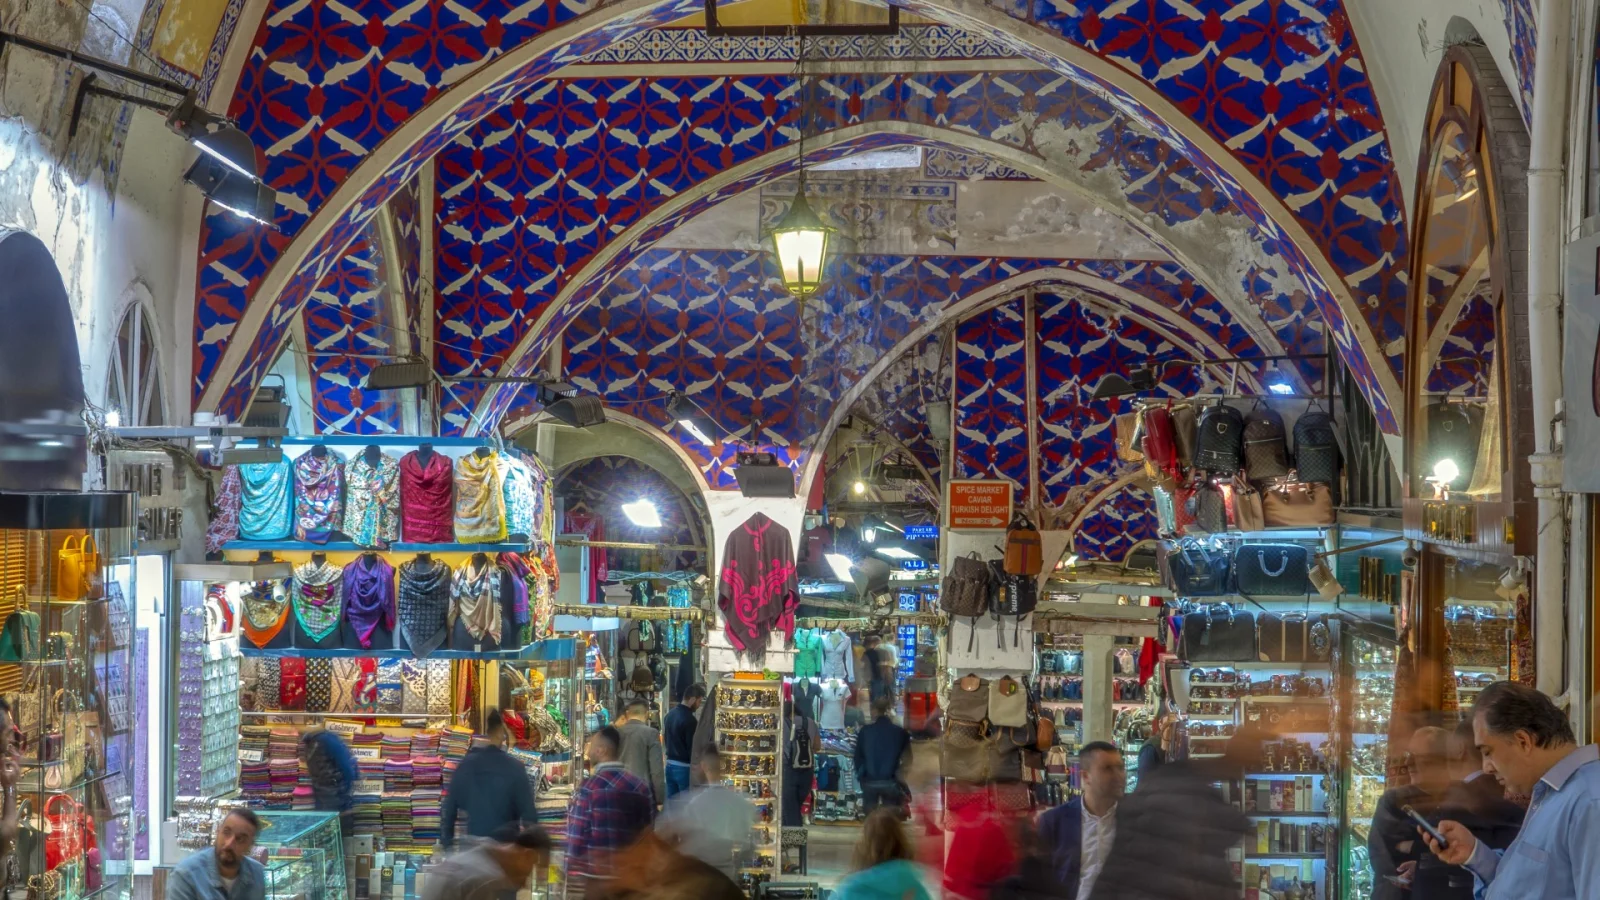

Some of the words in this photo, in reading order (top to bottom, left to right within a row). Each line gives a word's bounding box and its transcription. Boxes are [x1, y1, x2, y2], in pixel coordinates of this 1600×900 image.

[956, 486, 976, 494] SPICE
[976, 486, 1004, 494] MARKET
[968, 496, 992, 504] CAVIAR
[951, 506, 980, 514] TURKISH
[980, 506, 1009, 514] DELIGHT
[140, 506, 183, 541] SILVER
[329, 722, 358, 733] Cashmere
[351, 748, 373, 757] ashmere
